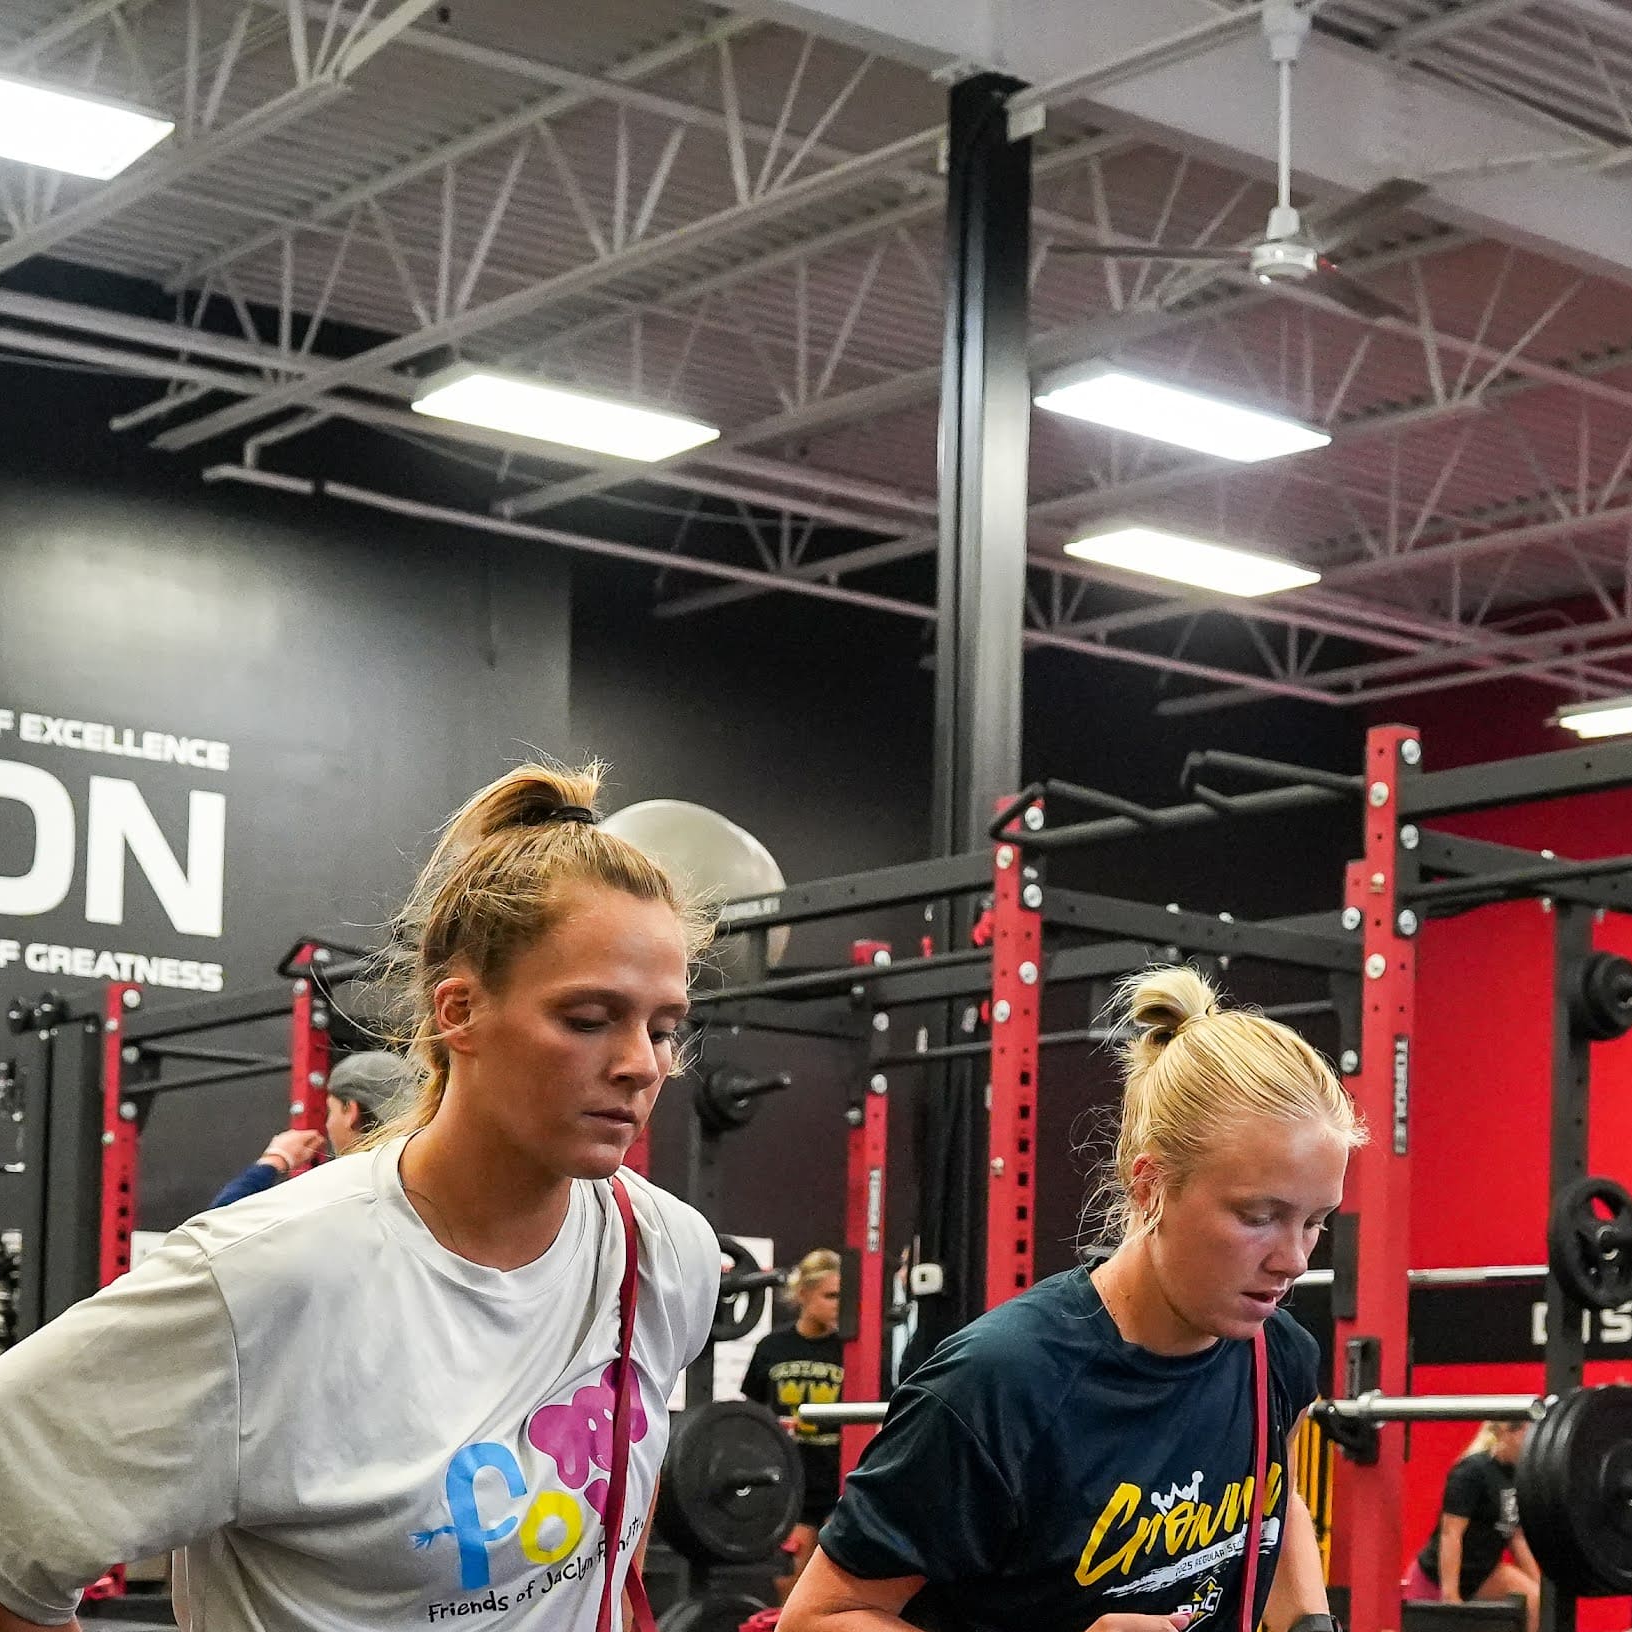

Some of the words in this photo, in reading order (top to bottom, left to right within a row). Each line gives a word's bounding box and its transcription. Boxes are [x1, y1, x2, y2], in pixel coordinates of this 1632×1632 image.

[21, 712, 230, 771] EXCELLENCE
[25, 942, 224, 993] GREATNESS
[429, 1590, 509, 1622] Friends
[517, 1580, 535, 1602] of
